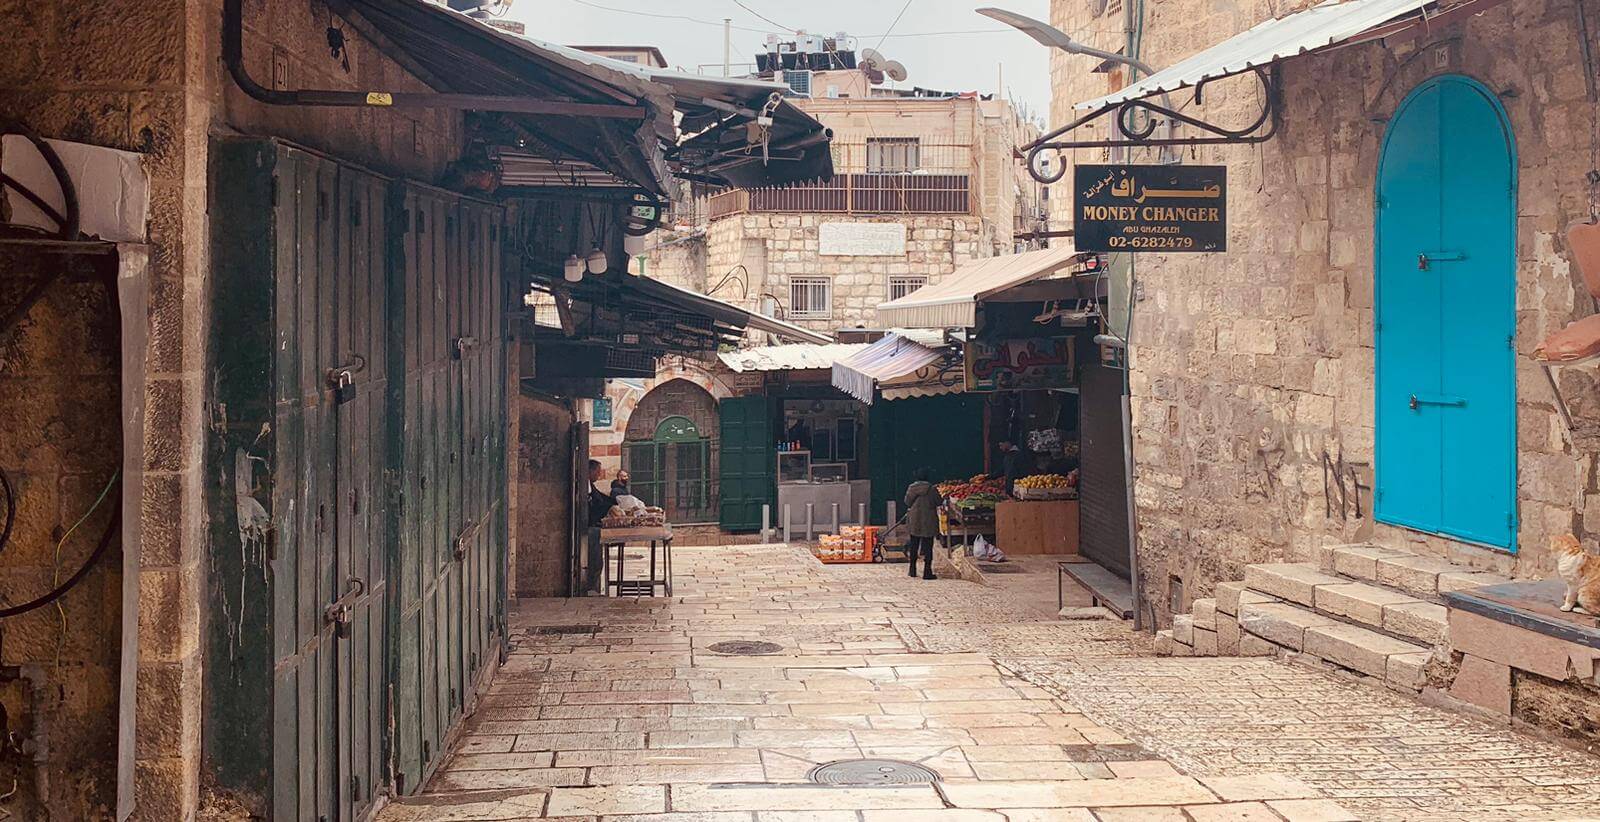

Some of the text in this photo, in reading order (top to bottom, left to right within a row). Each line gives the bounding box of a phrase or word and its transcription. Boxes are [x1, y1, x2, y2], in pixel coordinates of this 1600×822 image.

[277, 62, 287, 88] 21
[1083, 205, 1220, 221] MONEY CHANGER
[1140, 226, 1180, 234] GHAZALEH
[1109, 236, 1193, 248] 02-6282479
